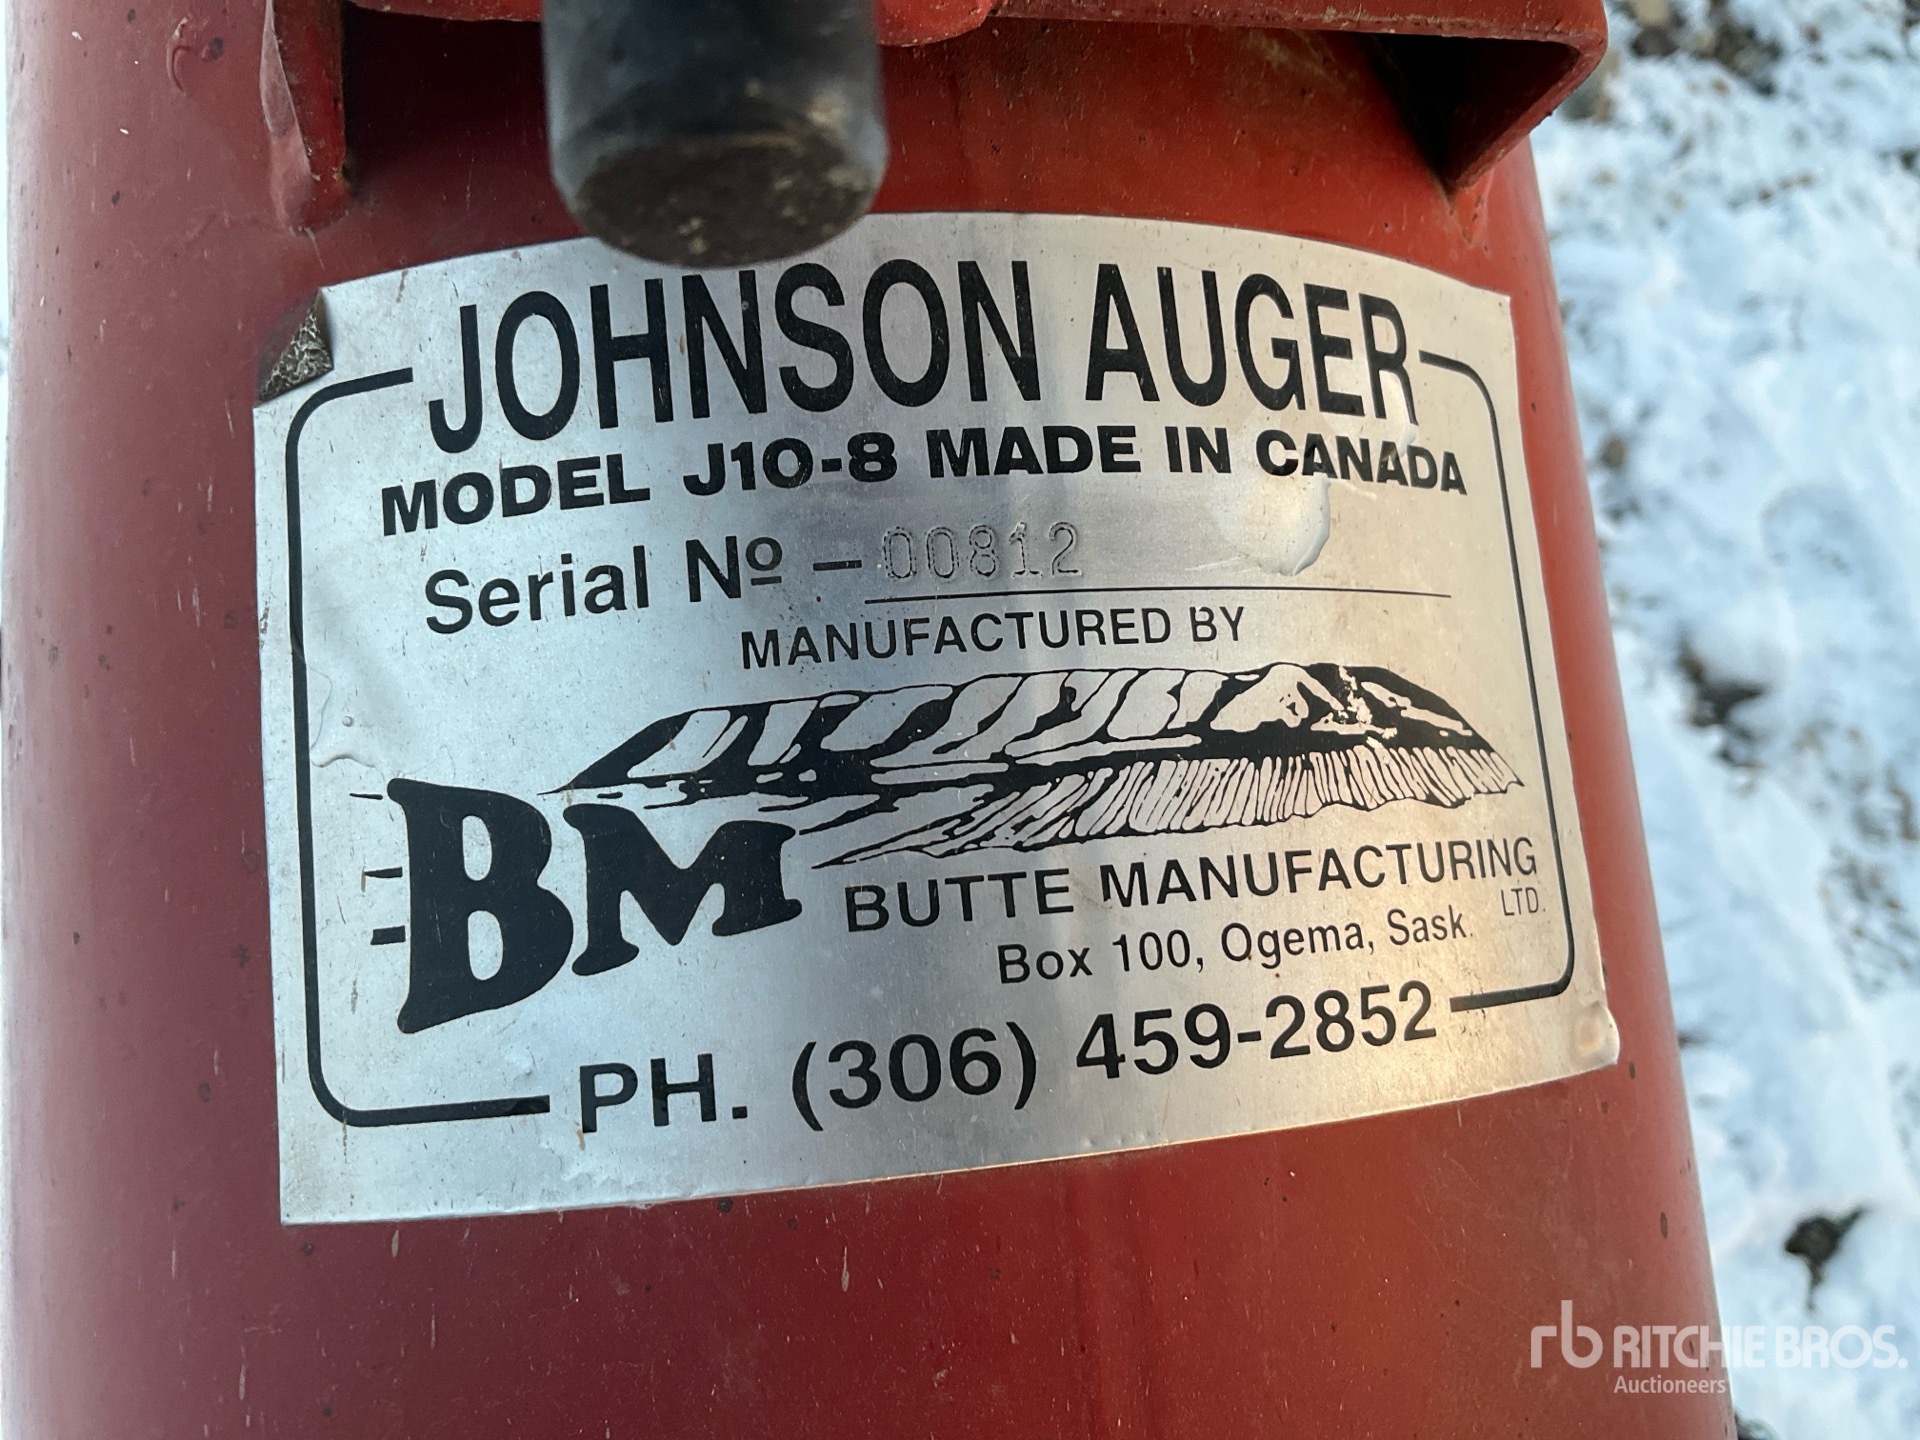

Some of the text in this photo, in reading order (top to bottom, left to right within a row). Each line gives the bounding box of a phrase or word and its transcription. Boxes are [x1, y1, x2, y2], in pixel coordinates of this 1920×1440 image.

[429, 258, 1418, 454] JOHNSON AUGER
[381, 425, 1468, 537] MODEL J10-8 MADE IN CANADA
[425, 545, 650, 635] Serial
[742, 606, 1245, 671] MANUFACTURED BY
[386, 777, 803, 1035] BM
[845, 835, 1538, 934] BUTTE MANUFACTURING
[998, 941, 1093, 985] Box
[1112, 929, 1206, 975] 100,
[1221, 917, 1376, 969] Ogema,
[579, 979, 1438, 1133] PH. (306) 459-2852
